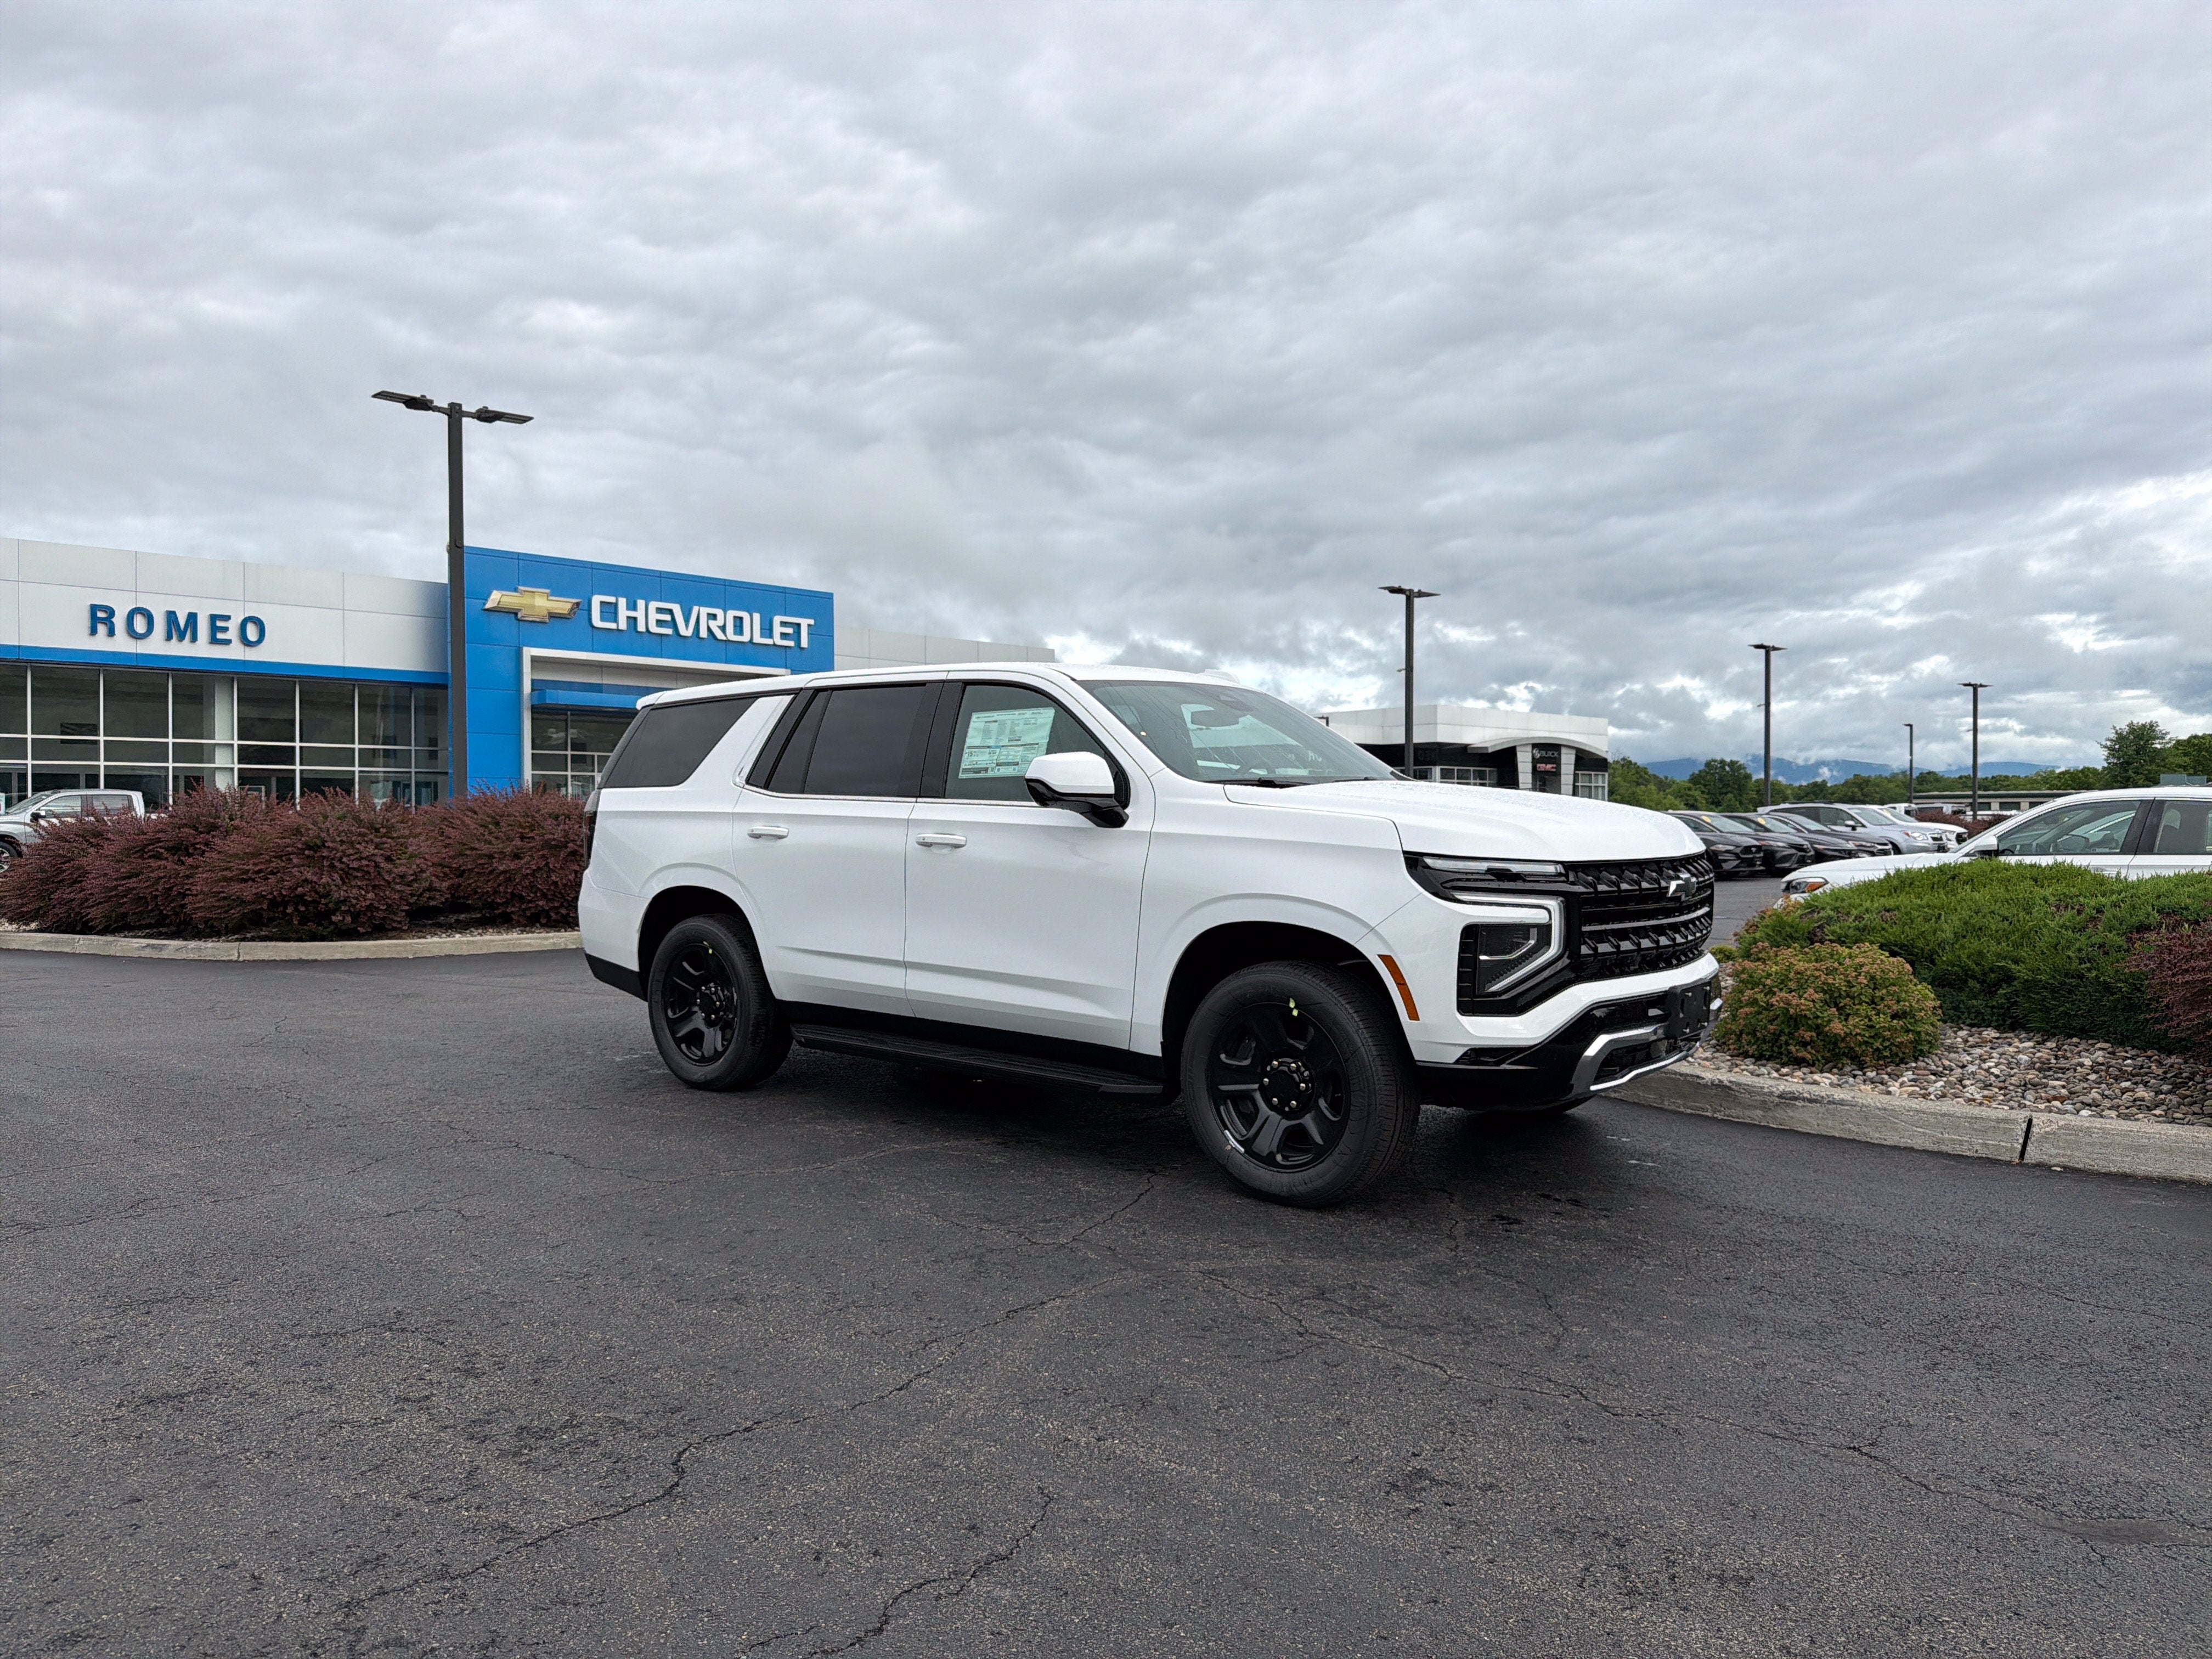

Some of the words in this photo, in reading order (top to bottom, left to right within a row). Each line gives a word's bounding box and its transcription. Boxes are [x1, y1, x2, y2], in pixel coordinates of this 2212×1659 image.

[89, 603, 266, 647] ROMEO
[591, 594, 815, 648] CHEVROLET
[1536, 763, 1556, 772] GMC
